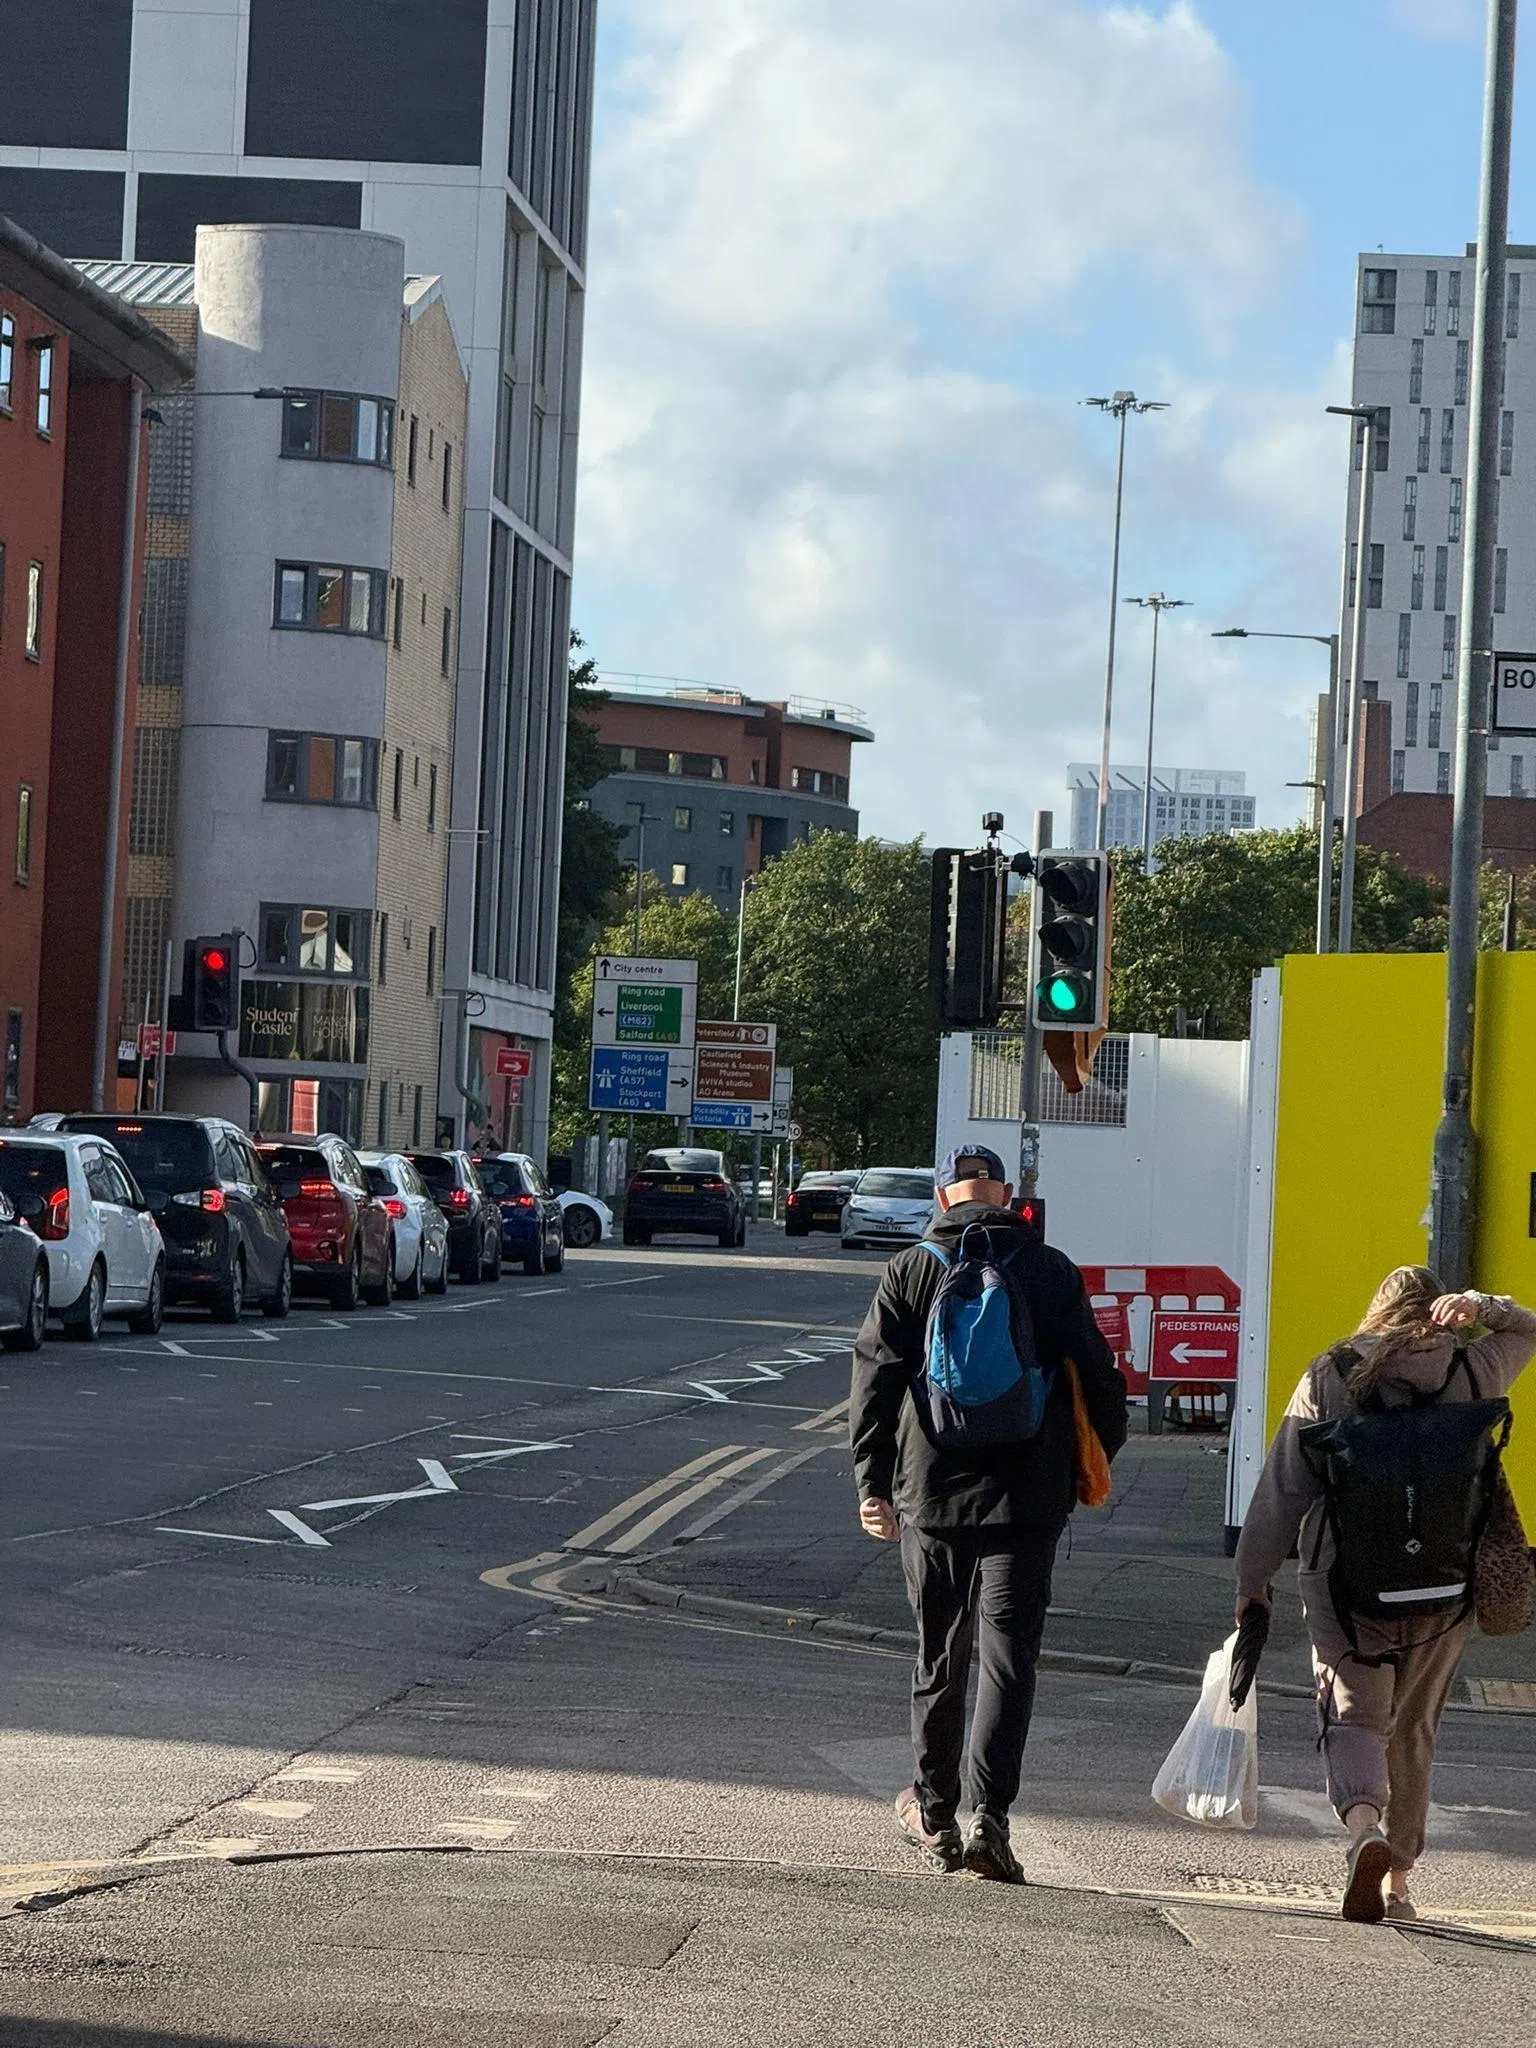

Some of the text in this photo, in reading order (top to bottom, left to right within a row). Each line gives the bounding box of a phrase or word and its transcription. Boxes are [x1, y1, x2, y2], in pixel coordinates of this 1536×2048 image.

[1503, 668, 1536, 690] BO
[614, 963, 664, 974] City centre
[621, 986, 666, 997] Ring road
[621, 1001, 663, 1012] Liverpool
[246, 1006, 300, 1023] Student
[621, 1015, 653, 1026] (M62)
[251, 1021, 292, 1036] Castle
[619, 1029, 654, 1040] Salford
[621, 1051, 666, 1062] Ring road
[700, 1050, 742, 1060] Castlefield
[620, 1065, 662, 1077] Sheffield
[700, 1059, 729, 1069] Science
[738, 1061, 770, 1072] Industry
[719, 1069, 751, 1078] Museum
[619, 1075, 645, 1086] (A57)
[699, 1077, 724, 1087] AVIVA
[619, 1087, 662, 1099] Stockport
[618, 1097, 640, 1107] (A6)
[693, 1114, 722, 1124] Victoria
[1159, 1321, 1240, 1333] PEDESTRIANS
